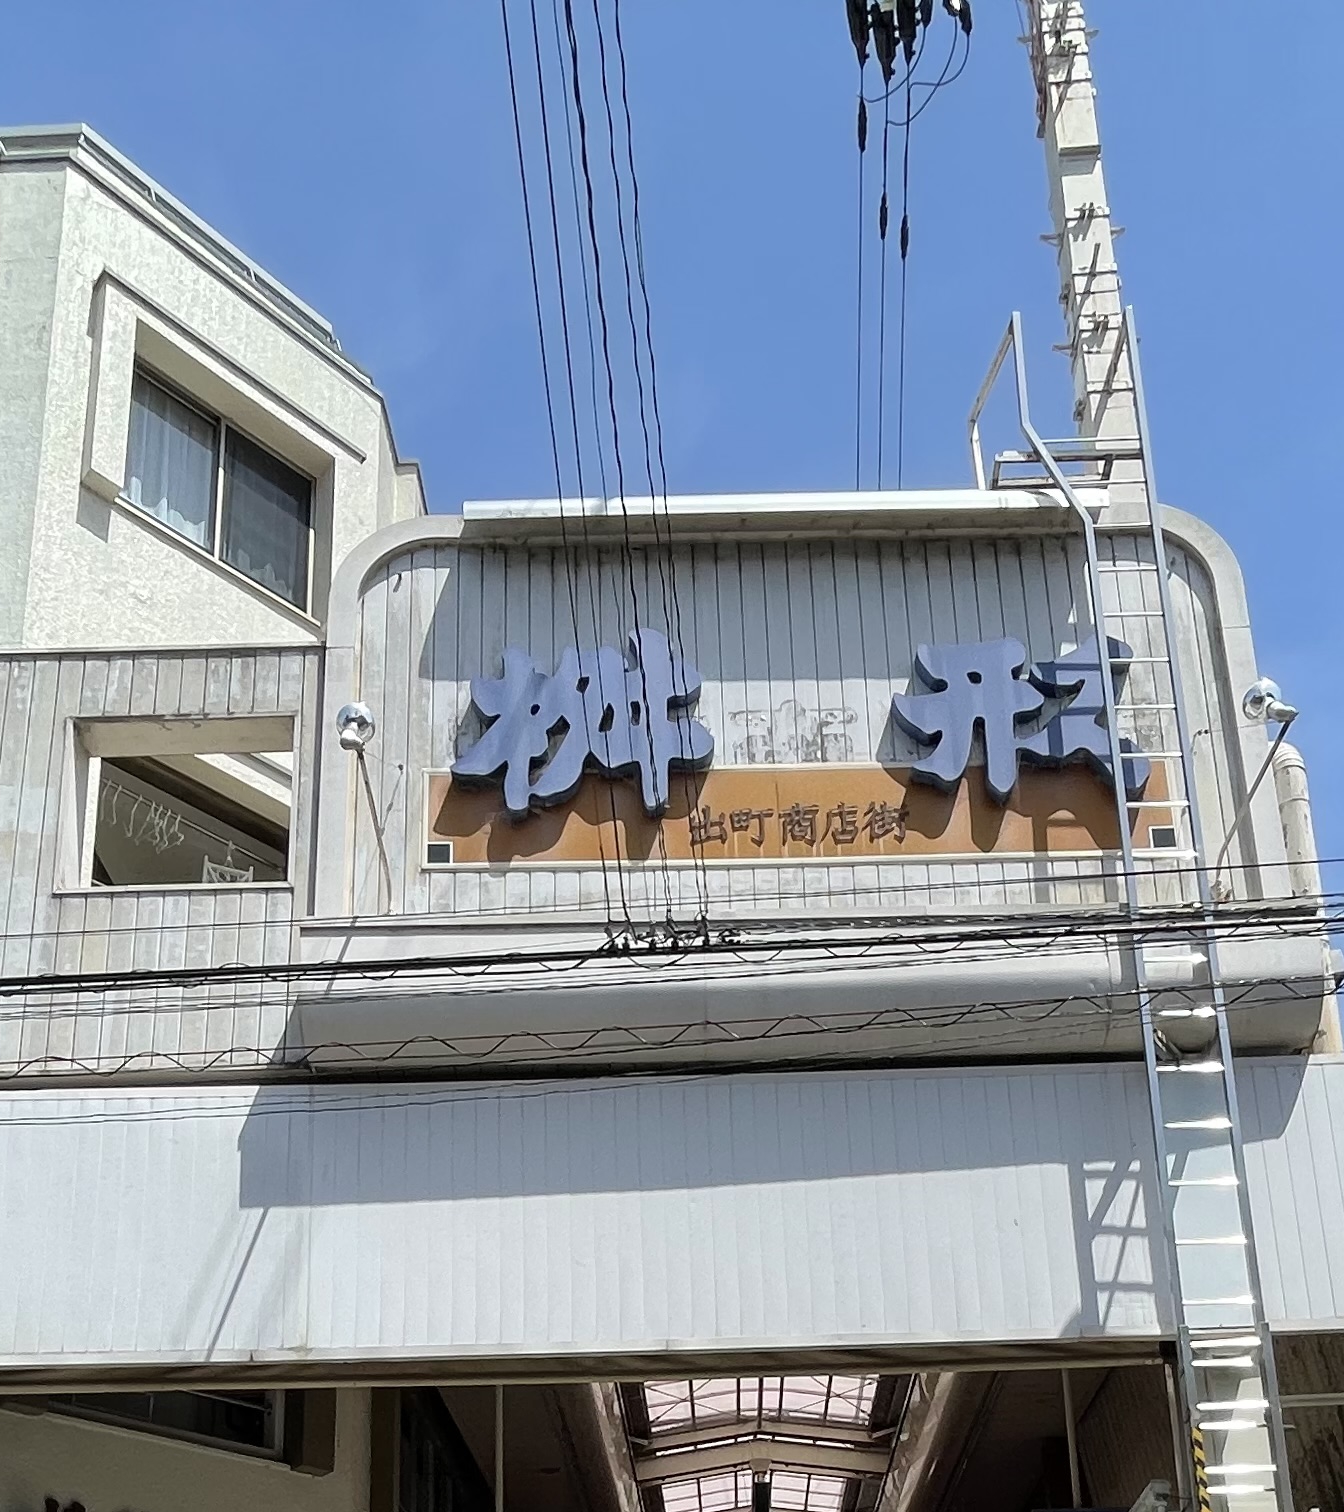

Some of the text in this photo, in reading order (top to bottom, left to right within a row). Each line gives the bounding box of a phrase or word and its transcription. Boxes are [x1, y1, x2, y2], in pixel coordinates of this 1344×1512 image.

[689, 800, 909, 847] 出町商店街
